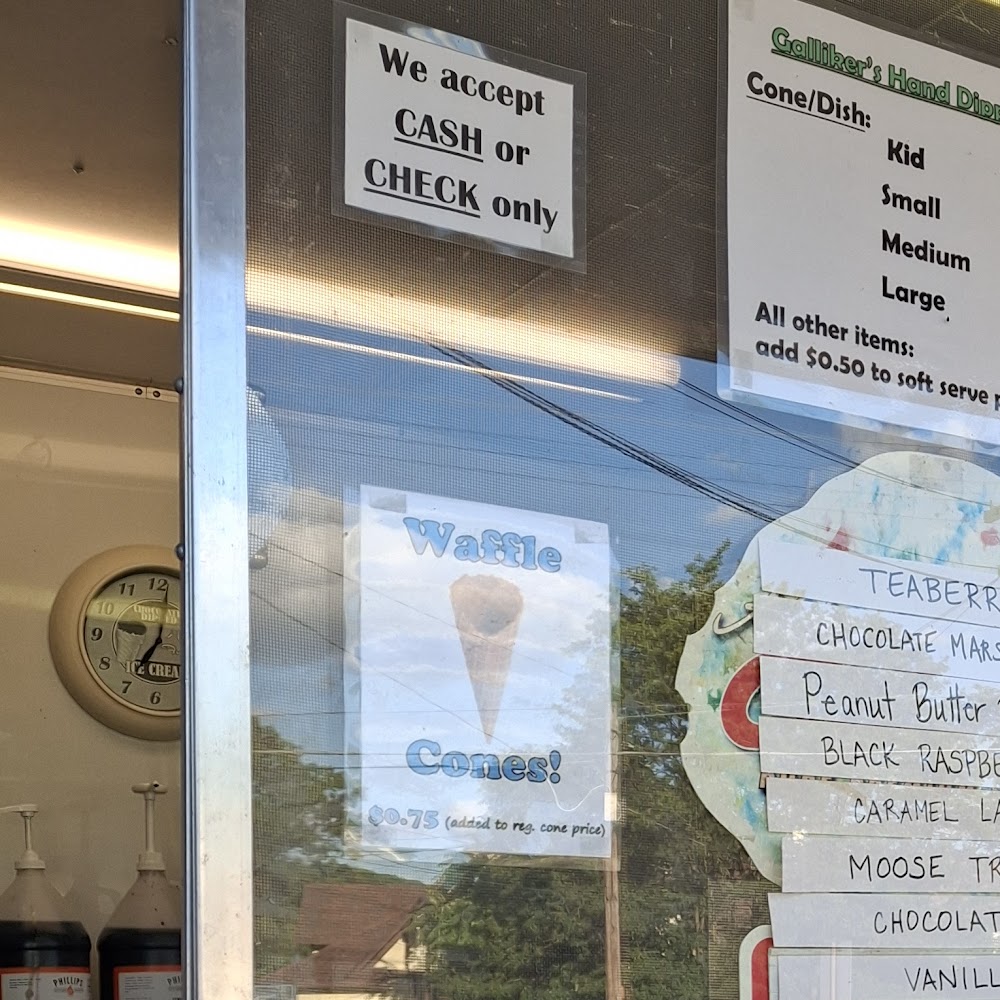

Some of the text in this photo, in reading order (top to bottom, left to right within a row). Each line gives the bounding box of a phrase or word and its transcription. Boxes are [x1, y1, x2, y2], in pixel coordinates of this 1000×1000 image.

[378, 43, 545, 116] We accept
[771, 27, 882, 84] Galliker's
[888, 64, 951, 105] Hand
[747, 71, 872, 128] Cone/Dish:
[395, 108, 530, 166] CASH or
[887, 138, 925, 170] Kid
[364, 158, 559, 234] CHECK only
[881, 183, 941, 220] Small
[881, 229, 971, 273] Medium
[881, 275, 946, 312] Large
[754, 301, 915, 359] All other items:
[755, 337, 799, 365] add
[806, 345, 865, 379] $0.50
[871, 361, 892, 384] to
[897, 370, 934, 394] soft
[940, 381, 989, 406] serve
[403, 517, 563, 573] Waffle
[118, 582, 136, 597] 11
[147, 577, 169, 592] 12
[90, 627, 103, 641] 9
[816, 622, 937, 653] CHOCOLATE
[98, 656, 111, 670] 8
[148, 663, 180, 679] CREA
[121, 680, 133, 694] 7
[150, 691, 162, 705] 6
[802, 670, 896, 721] Peanut
[912, 681, 987, 724] Butter
[405, 738, 562, 785] Cones!
[820, 736, 900, 769] BLACK
[368, 804, 606, 838] $0.75 (added to reg. cone price)
[854, 798, 959, 825] CARAMEL
[849, 854, 945, 883] MOOSE
[53, 976, 84, 987] PHILLIPS
